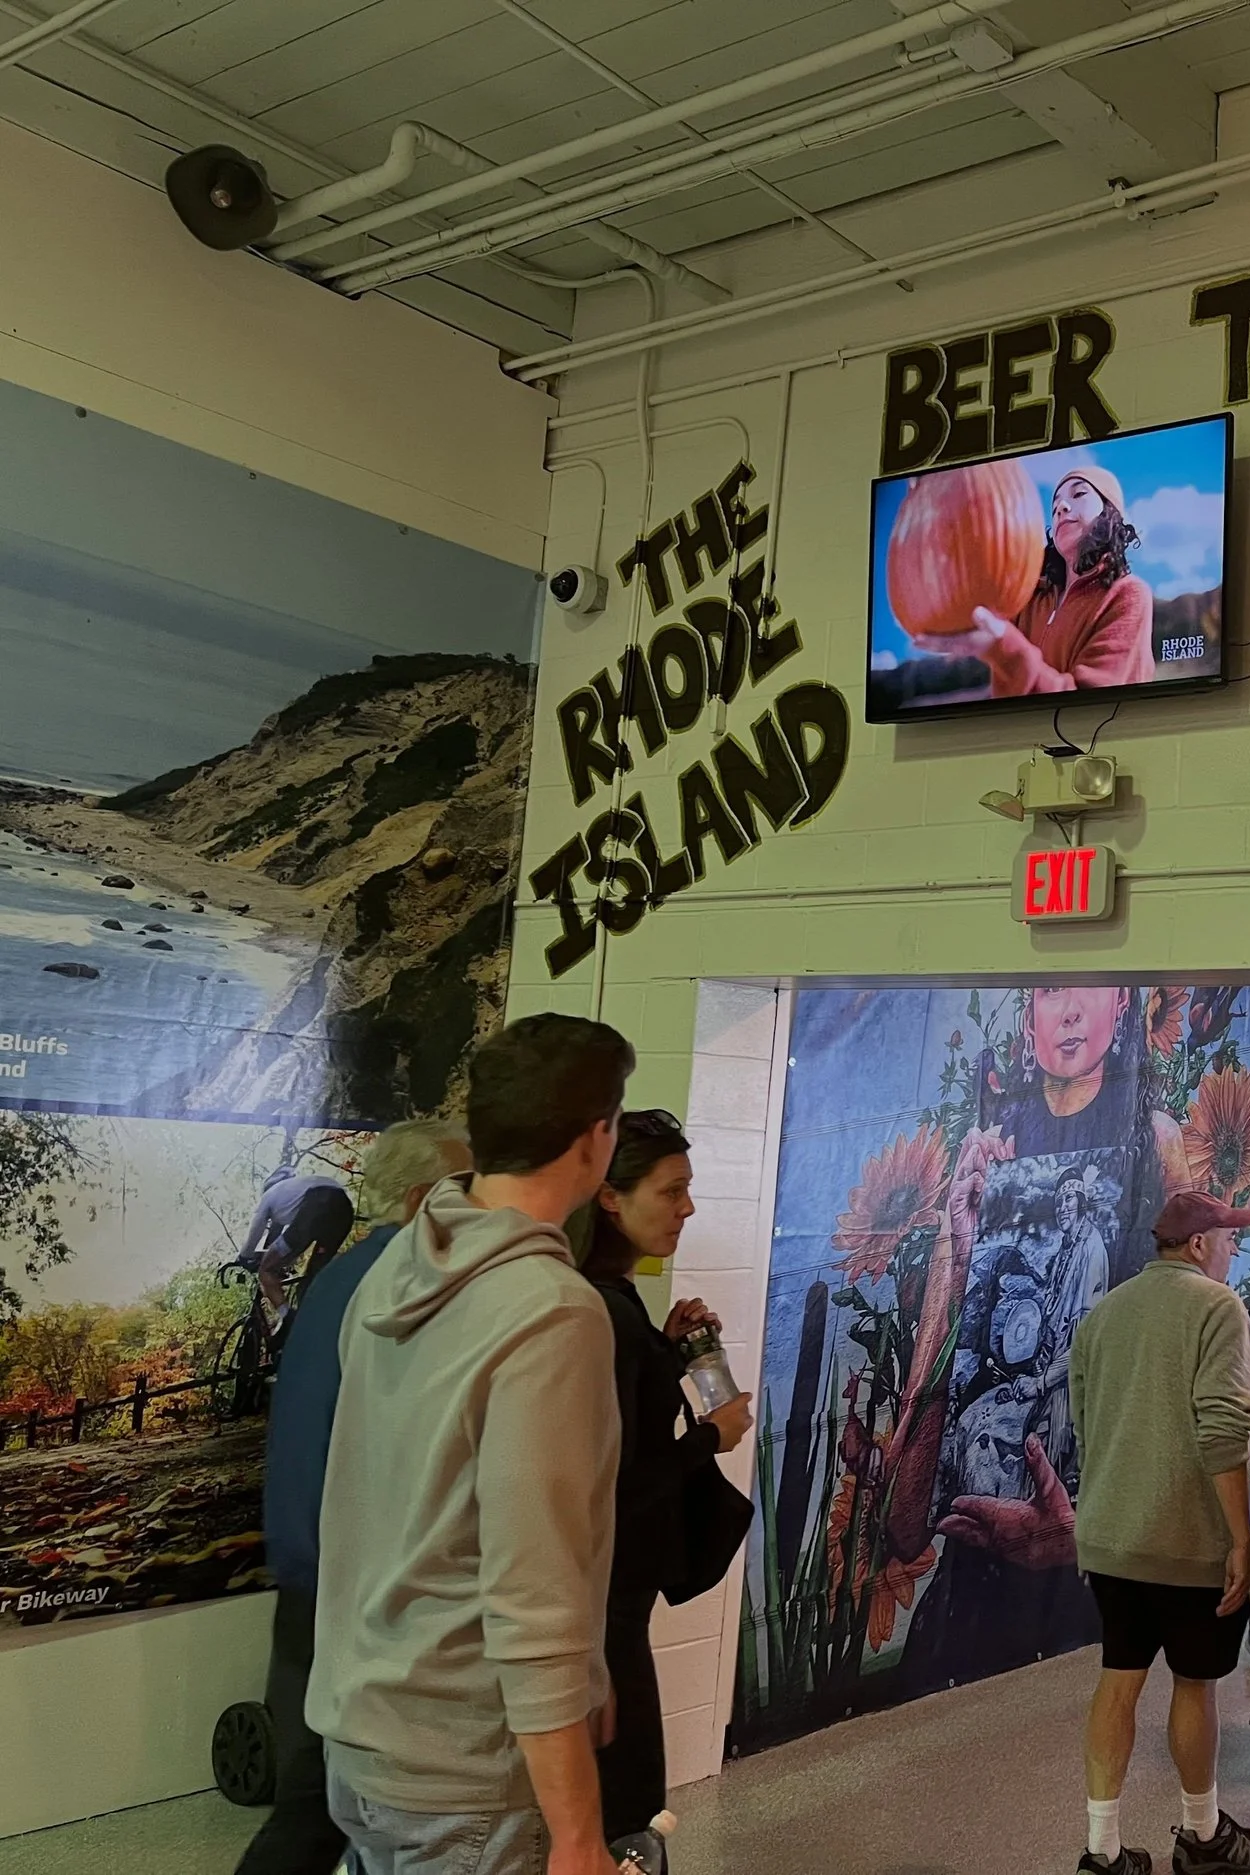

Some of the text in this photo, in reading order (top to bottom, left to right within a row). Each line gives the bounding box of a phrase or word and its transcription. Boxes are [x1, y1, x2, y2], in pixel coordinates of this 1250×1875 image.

[879, 305, 1119, 476] BEER
[616, 457, 771, 616] THE
[1161, 647, 1204, 662] ISLAND
[1162, 635, 1204, 651] RHODE
[556, 555, 803, 807] RHODE
[528, 680, 851, 980] ISLAND
[1025, 848, 1096, 915] EXIT
[0, 1033, 68, 1056] Bluffs
[16, 1586, 110, 1612] Bikeway
